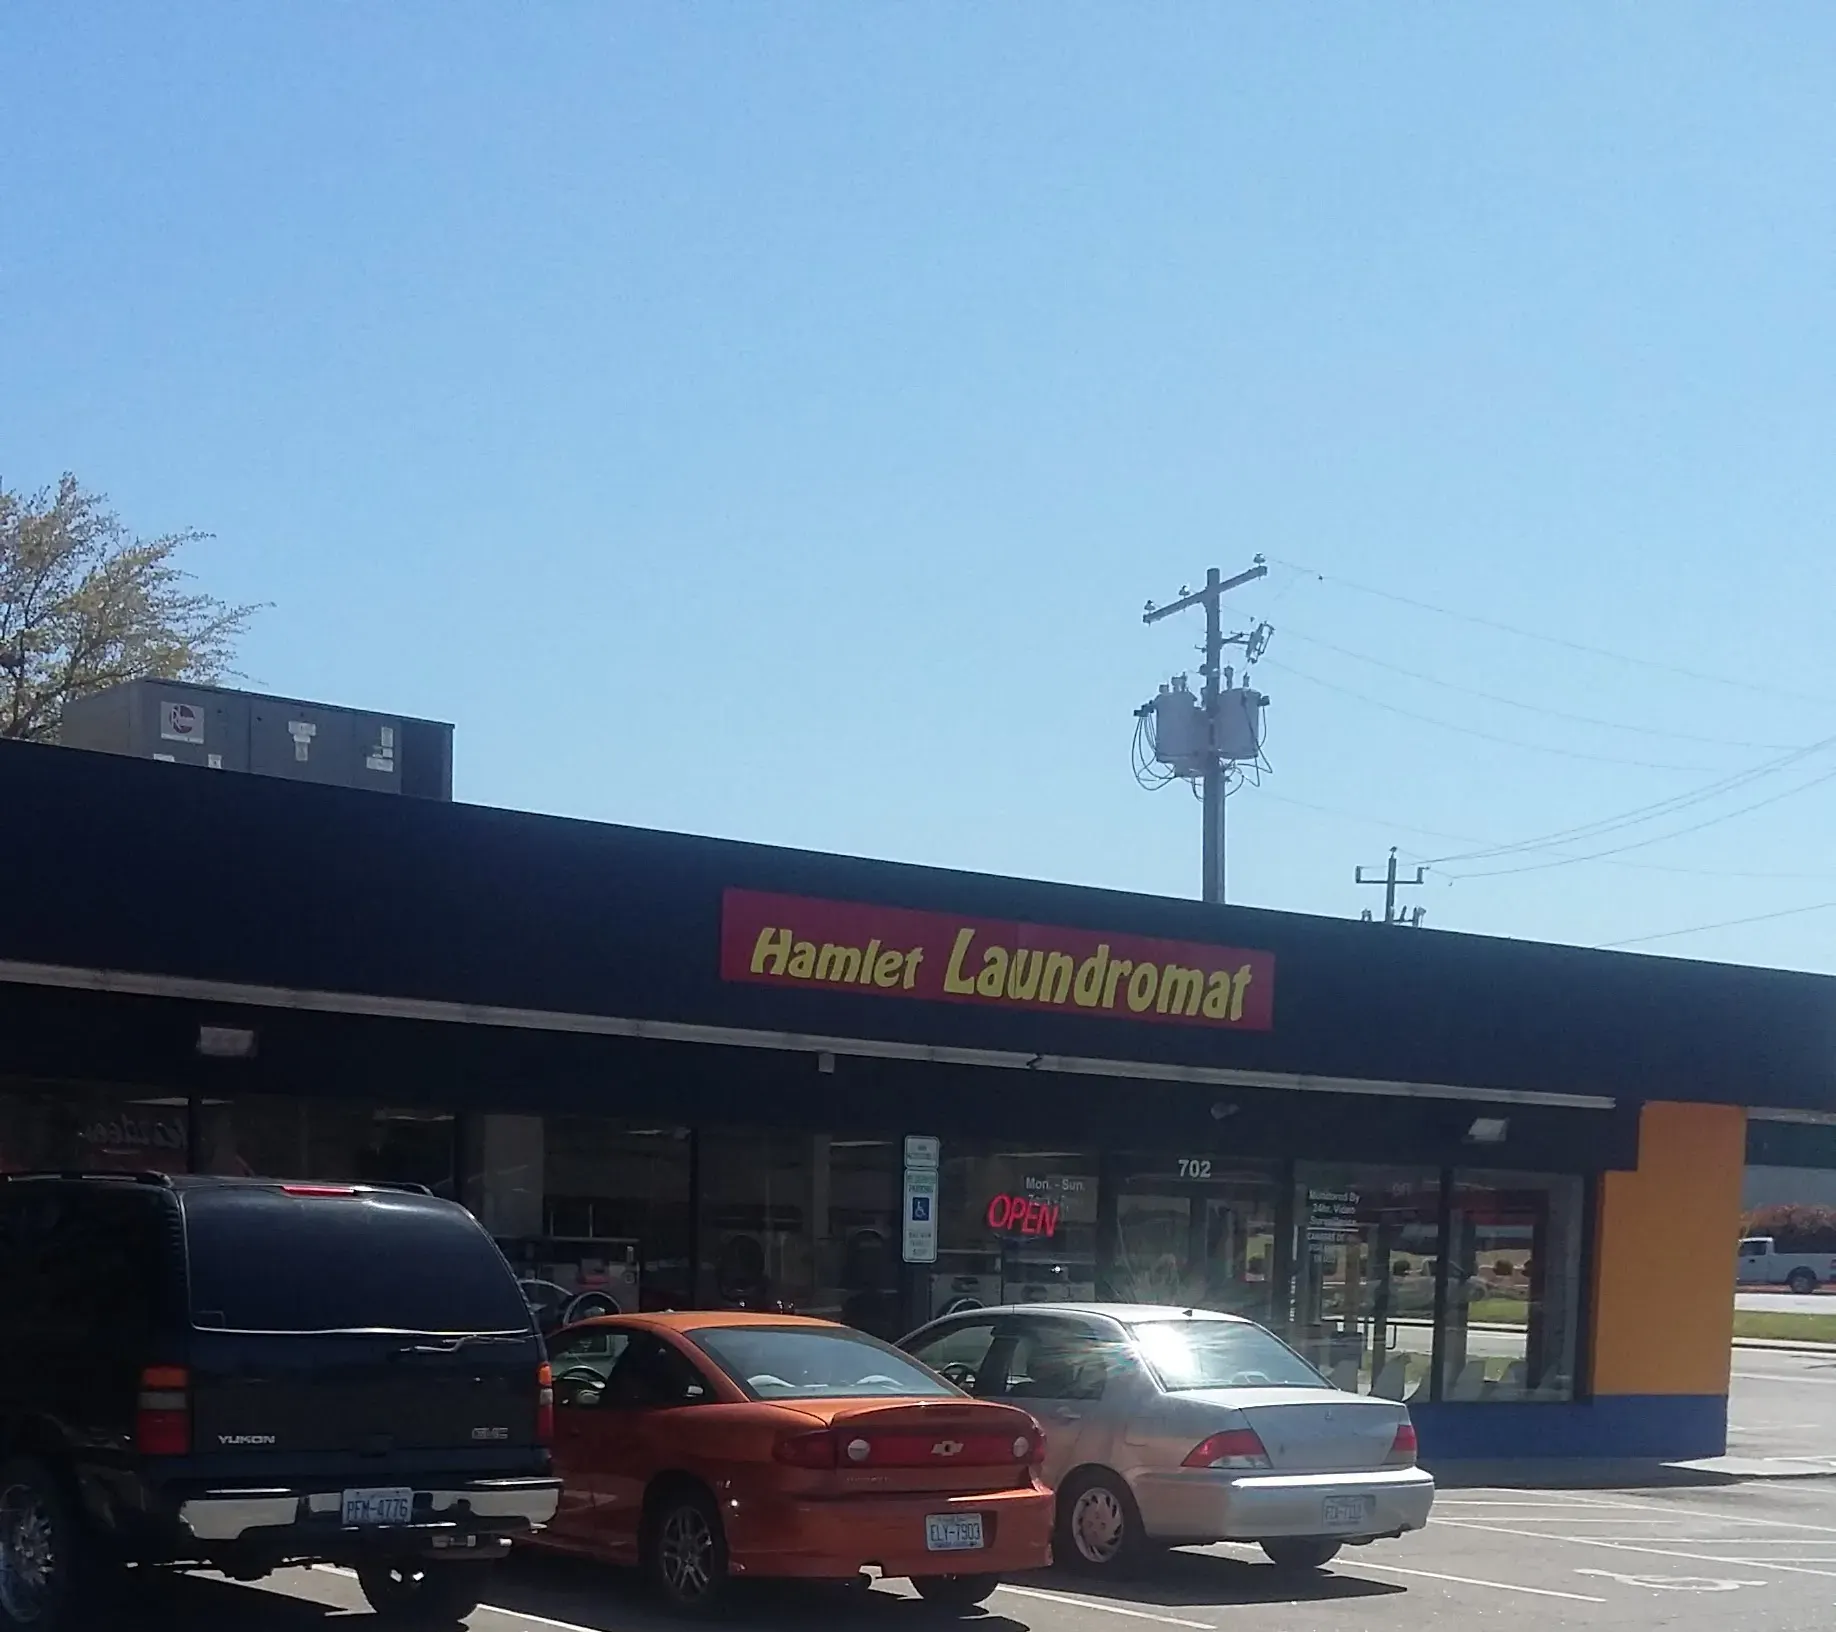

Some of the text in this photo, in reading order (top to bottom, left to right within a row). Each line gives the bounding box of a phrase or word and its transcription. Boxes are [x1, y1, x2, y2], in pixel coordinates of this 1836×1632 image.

[750, 927, 1252, 1022] Hamlet Laundromat
[1178, 1159, 1211, 1178] 702
[1026, 1177, 1051, 1190] Mon.
[1062, 1179, 1085, 1191] Sun.
[988, 1192, 1059, 1237] OPEN
[218, 1434, 276, 1445] YUKON
[472, 1427, 509, 1440] GMC
[347, 1499, 408, 1520] PFM-4776
[930, 1522, 981, 1542] ELY-7903
